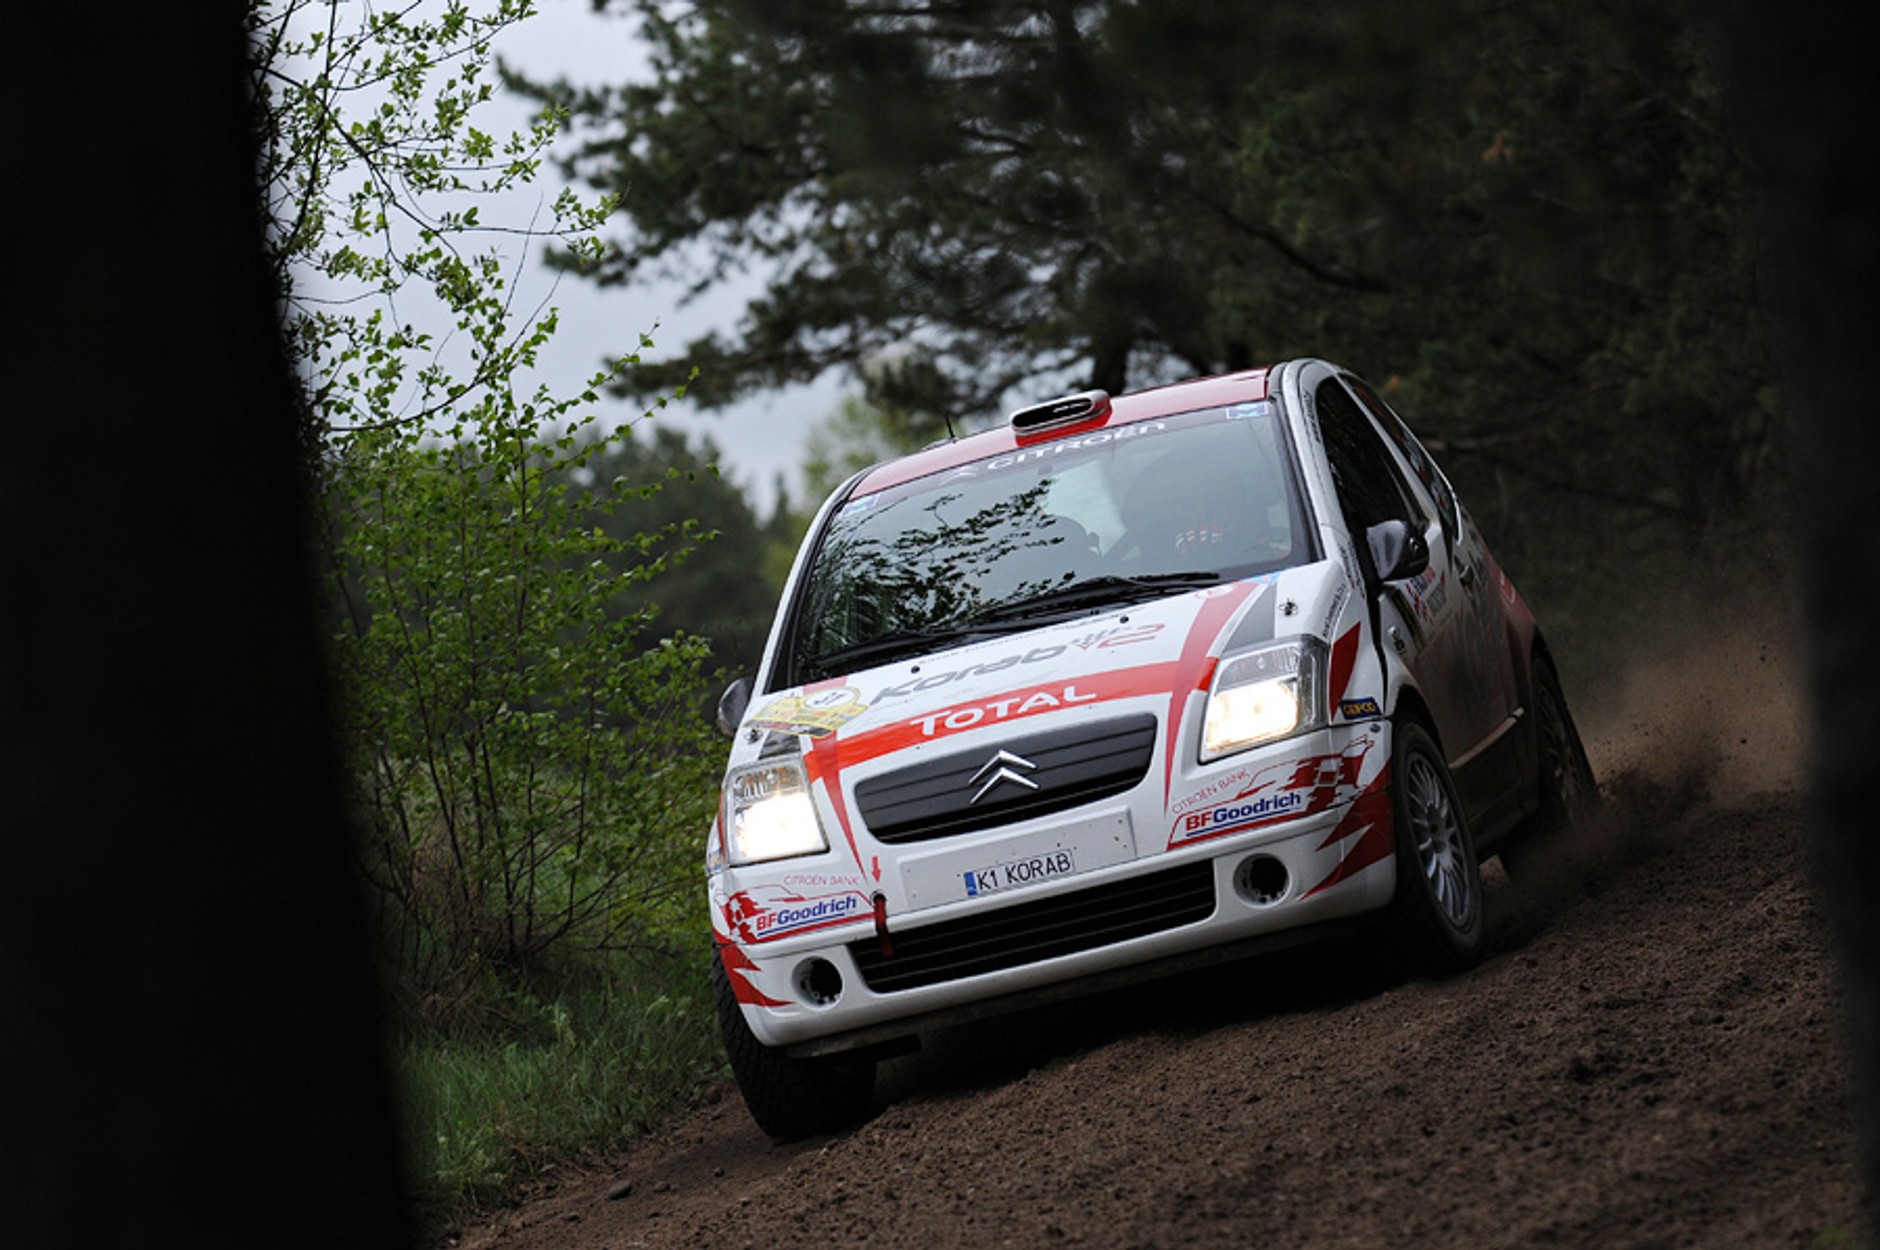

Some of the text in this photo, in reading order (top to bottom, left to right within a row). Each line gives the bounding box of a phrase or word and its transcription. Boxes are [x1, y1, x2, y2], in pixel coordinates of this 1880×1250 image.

[909, 686, 1097, 735] TOTAL
[1219, 768, 1251, 789] BANK
[1185, 791, 1301, 831] BFGoodrich
[829, 875, 860, 886] BANK
[977, 852, 1071, 890] K1 KORAB
[756, 895, 857, 931] BFGoodrich
